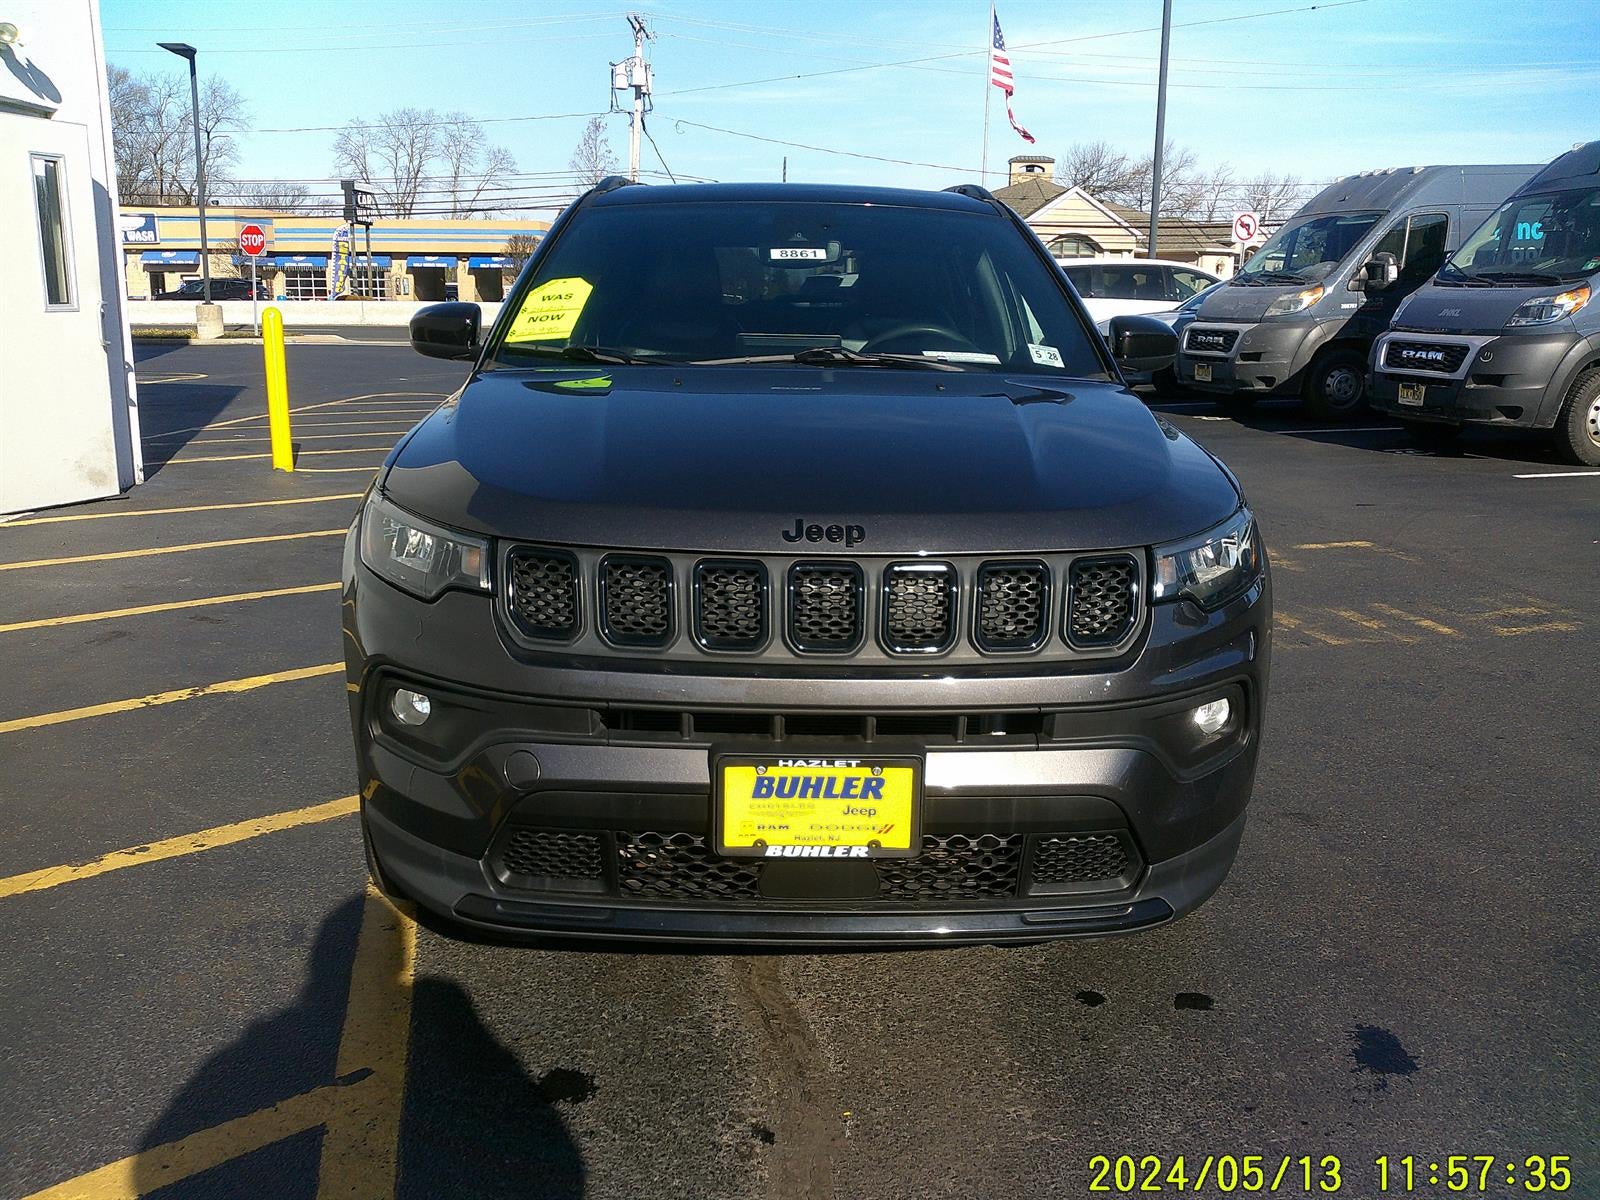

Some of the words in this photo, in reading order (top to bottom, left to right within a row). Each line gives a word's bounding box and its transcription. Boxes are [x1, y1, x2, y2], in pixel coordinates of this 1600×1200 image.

[241, 233, 264, 247] STOP
[779, 249, 817, 258] 8861
[541, 293, 574, 302] WAS
[527, 312, 566, 324] NOW
[1197, 335, 1225, 345] RAM
[1035, 350, 1043, 359] 5
[1047, 352, 1059, 362] 28
[1402, 349, 1446, 361] RAM
[781, 518, 866, 548] Jeep
[778, 759, 861, 768] HAZLET
[751, 775, 886, 800] BUHLER
[842, 804, 877, 817] Jeep
[810, 823, 881, 832] DODGE
[764, 845, 869, 858] BUHLER
